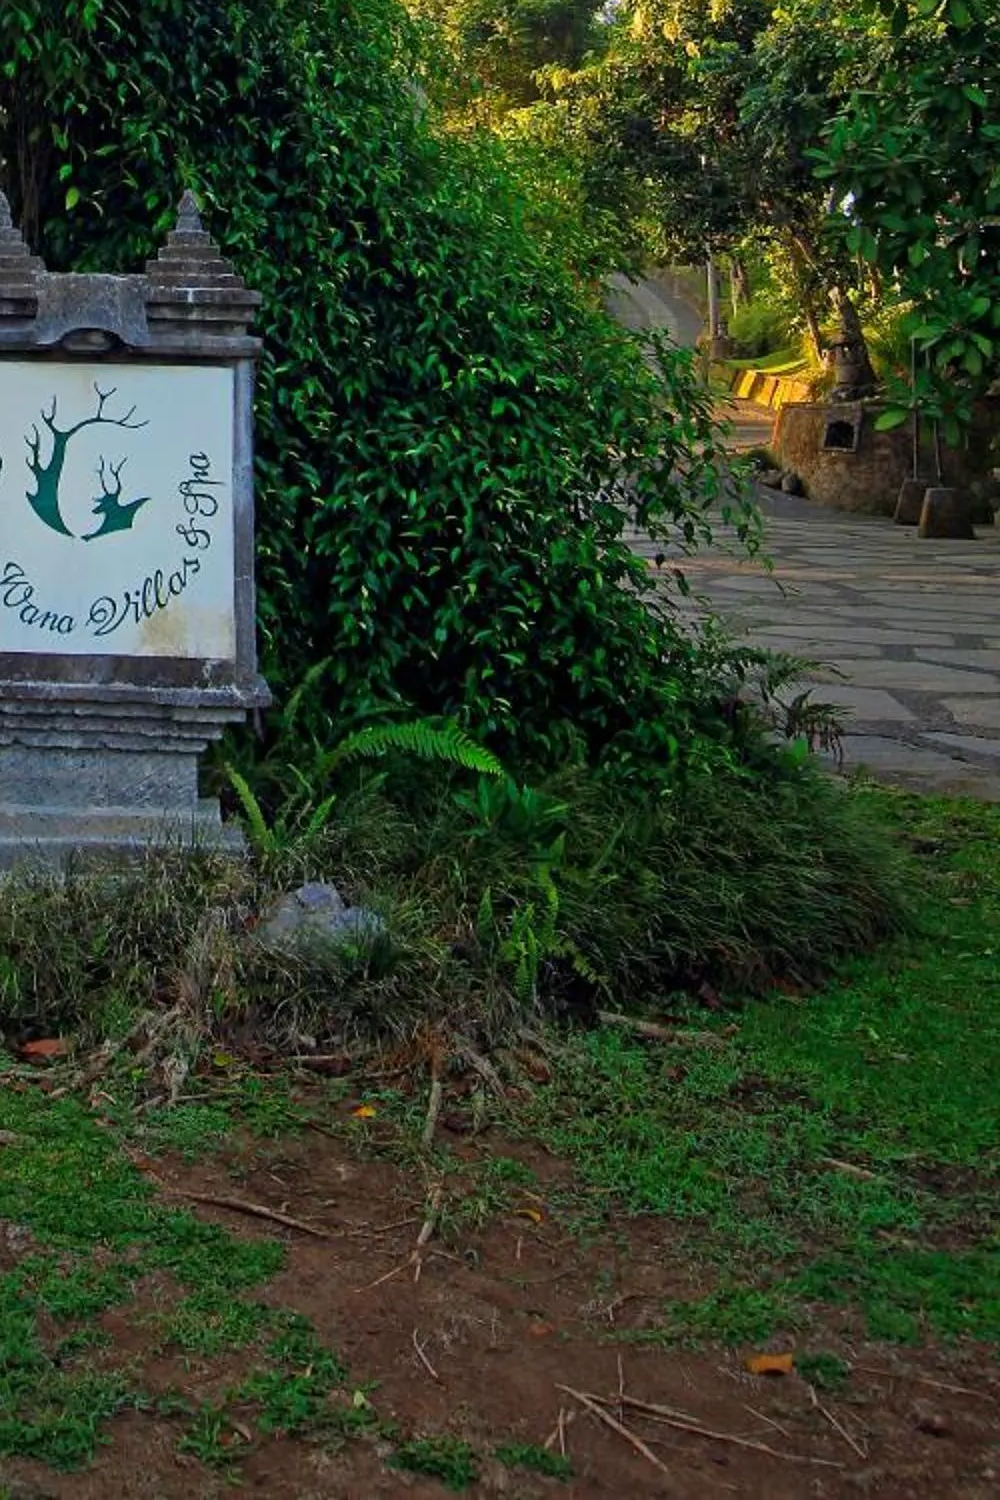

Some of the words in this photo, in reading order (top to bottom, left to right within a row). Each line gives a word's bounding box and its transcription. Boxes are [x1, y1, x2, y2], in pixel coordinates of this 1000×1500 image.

[178, 451, 226, 516] Spa
[176, 517, 210, 549] &
[85, 556, 201, 636] Villas
